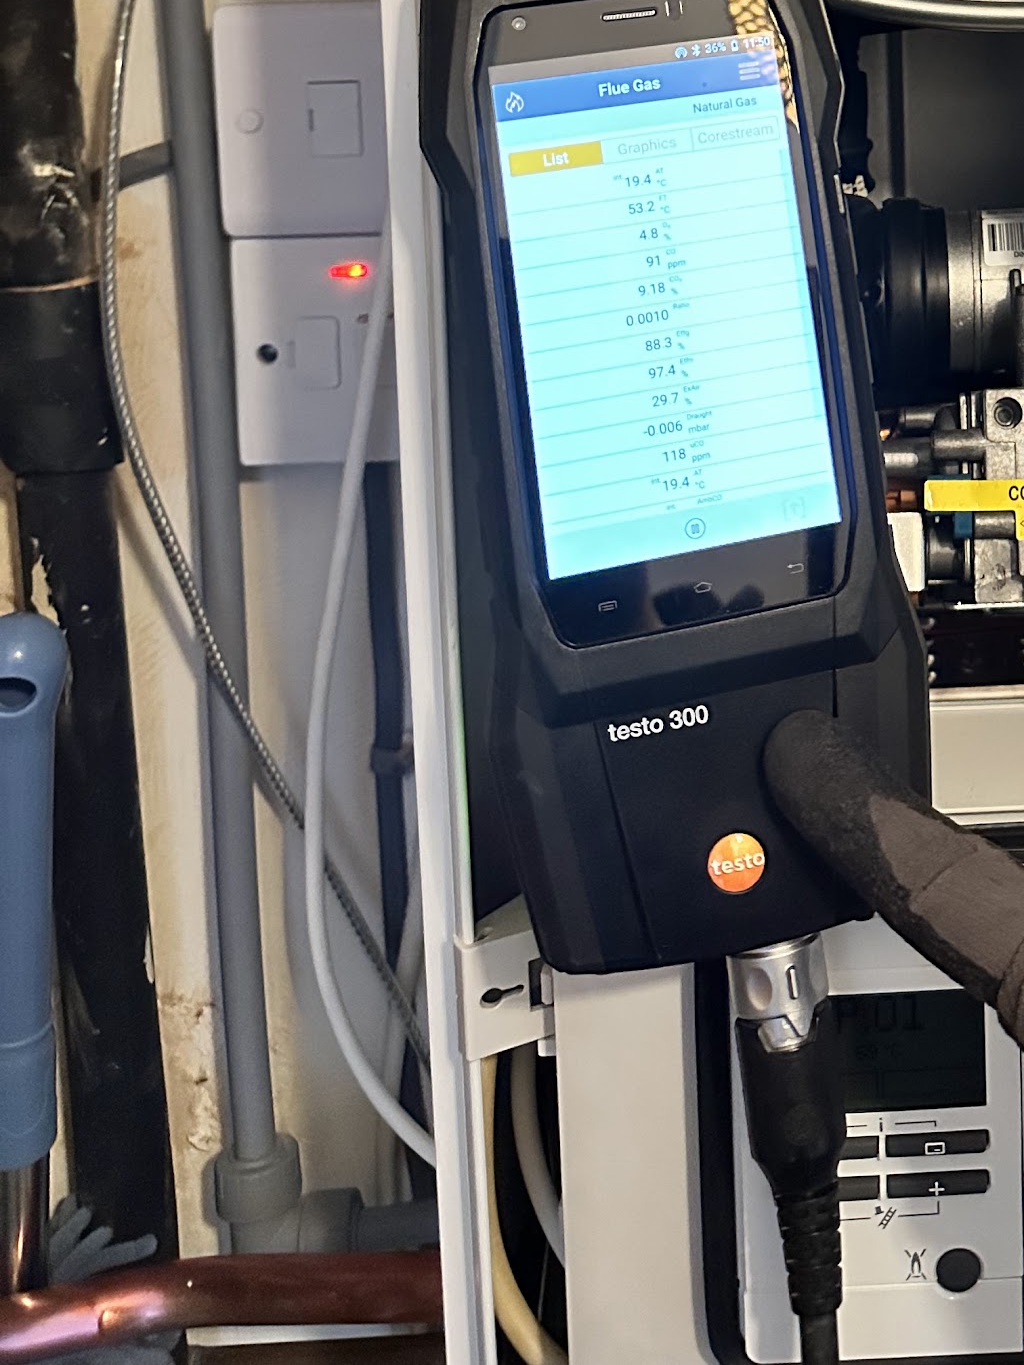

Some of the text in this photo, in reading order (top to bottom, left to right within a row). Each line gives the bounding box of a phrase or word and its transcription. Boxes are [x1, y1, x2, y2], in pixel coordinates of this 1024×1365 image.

[704, 36, 771, 54] 36% 11:50
[598, 77, 661, 97] Flue Gas
[692, 97, 757, 114] Natural Gas
[697, 124, 774, 144] Corestream
[617, 135, 677, 155] Graphics
[542, 151, 570, 168] List
[625, 174, 652, 188] 19.4
[628, 200, 655, 215] 53.2
[639, 227, 659, 241] 4.8
[646, 255, 687, 270] 91 ppm
[638, 281, 666, 296] 9.18
[626, 309, 669, 326] 0.0010
[645, 336, 672, 351] 88.3
[648, 364, 676, 379] 97.4
[652, 391, 679, 407] 29.7
[642, 420, 710, 436] -0.006 mbar
[662, 448, 711, 463] 118 ppm
[662, 476, 690, 491] 19.4
[607, 704, 710, 742] testo 300
[710, 851, 766, 876] testo
